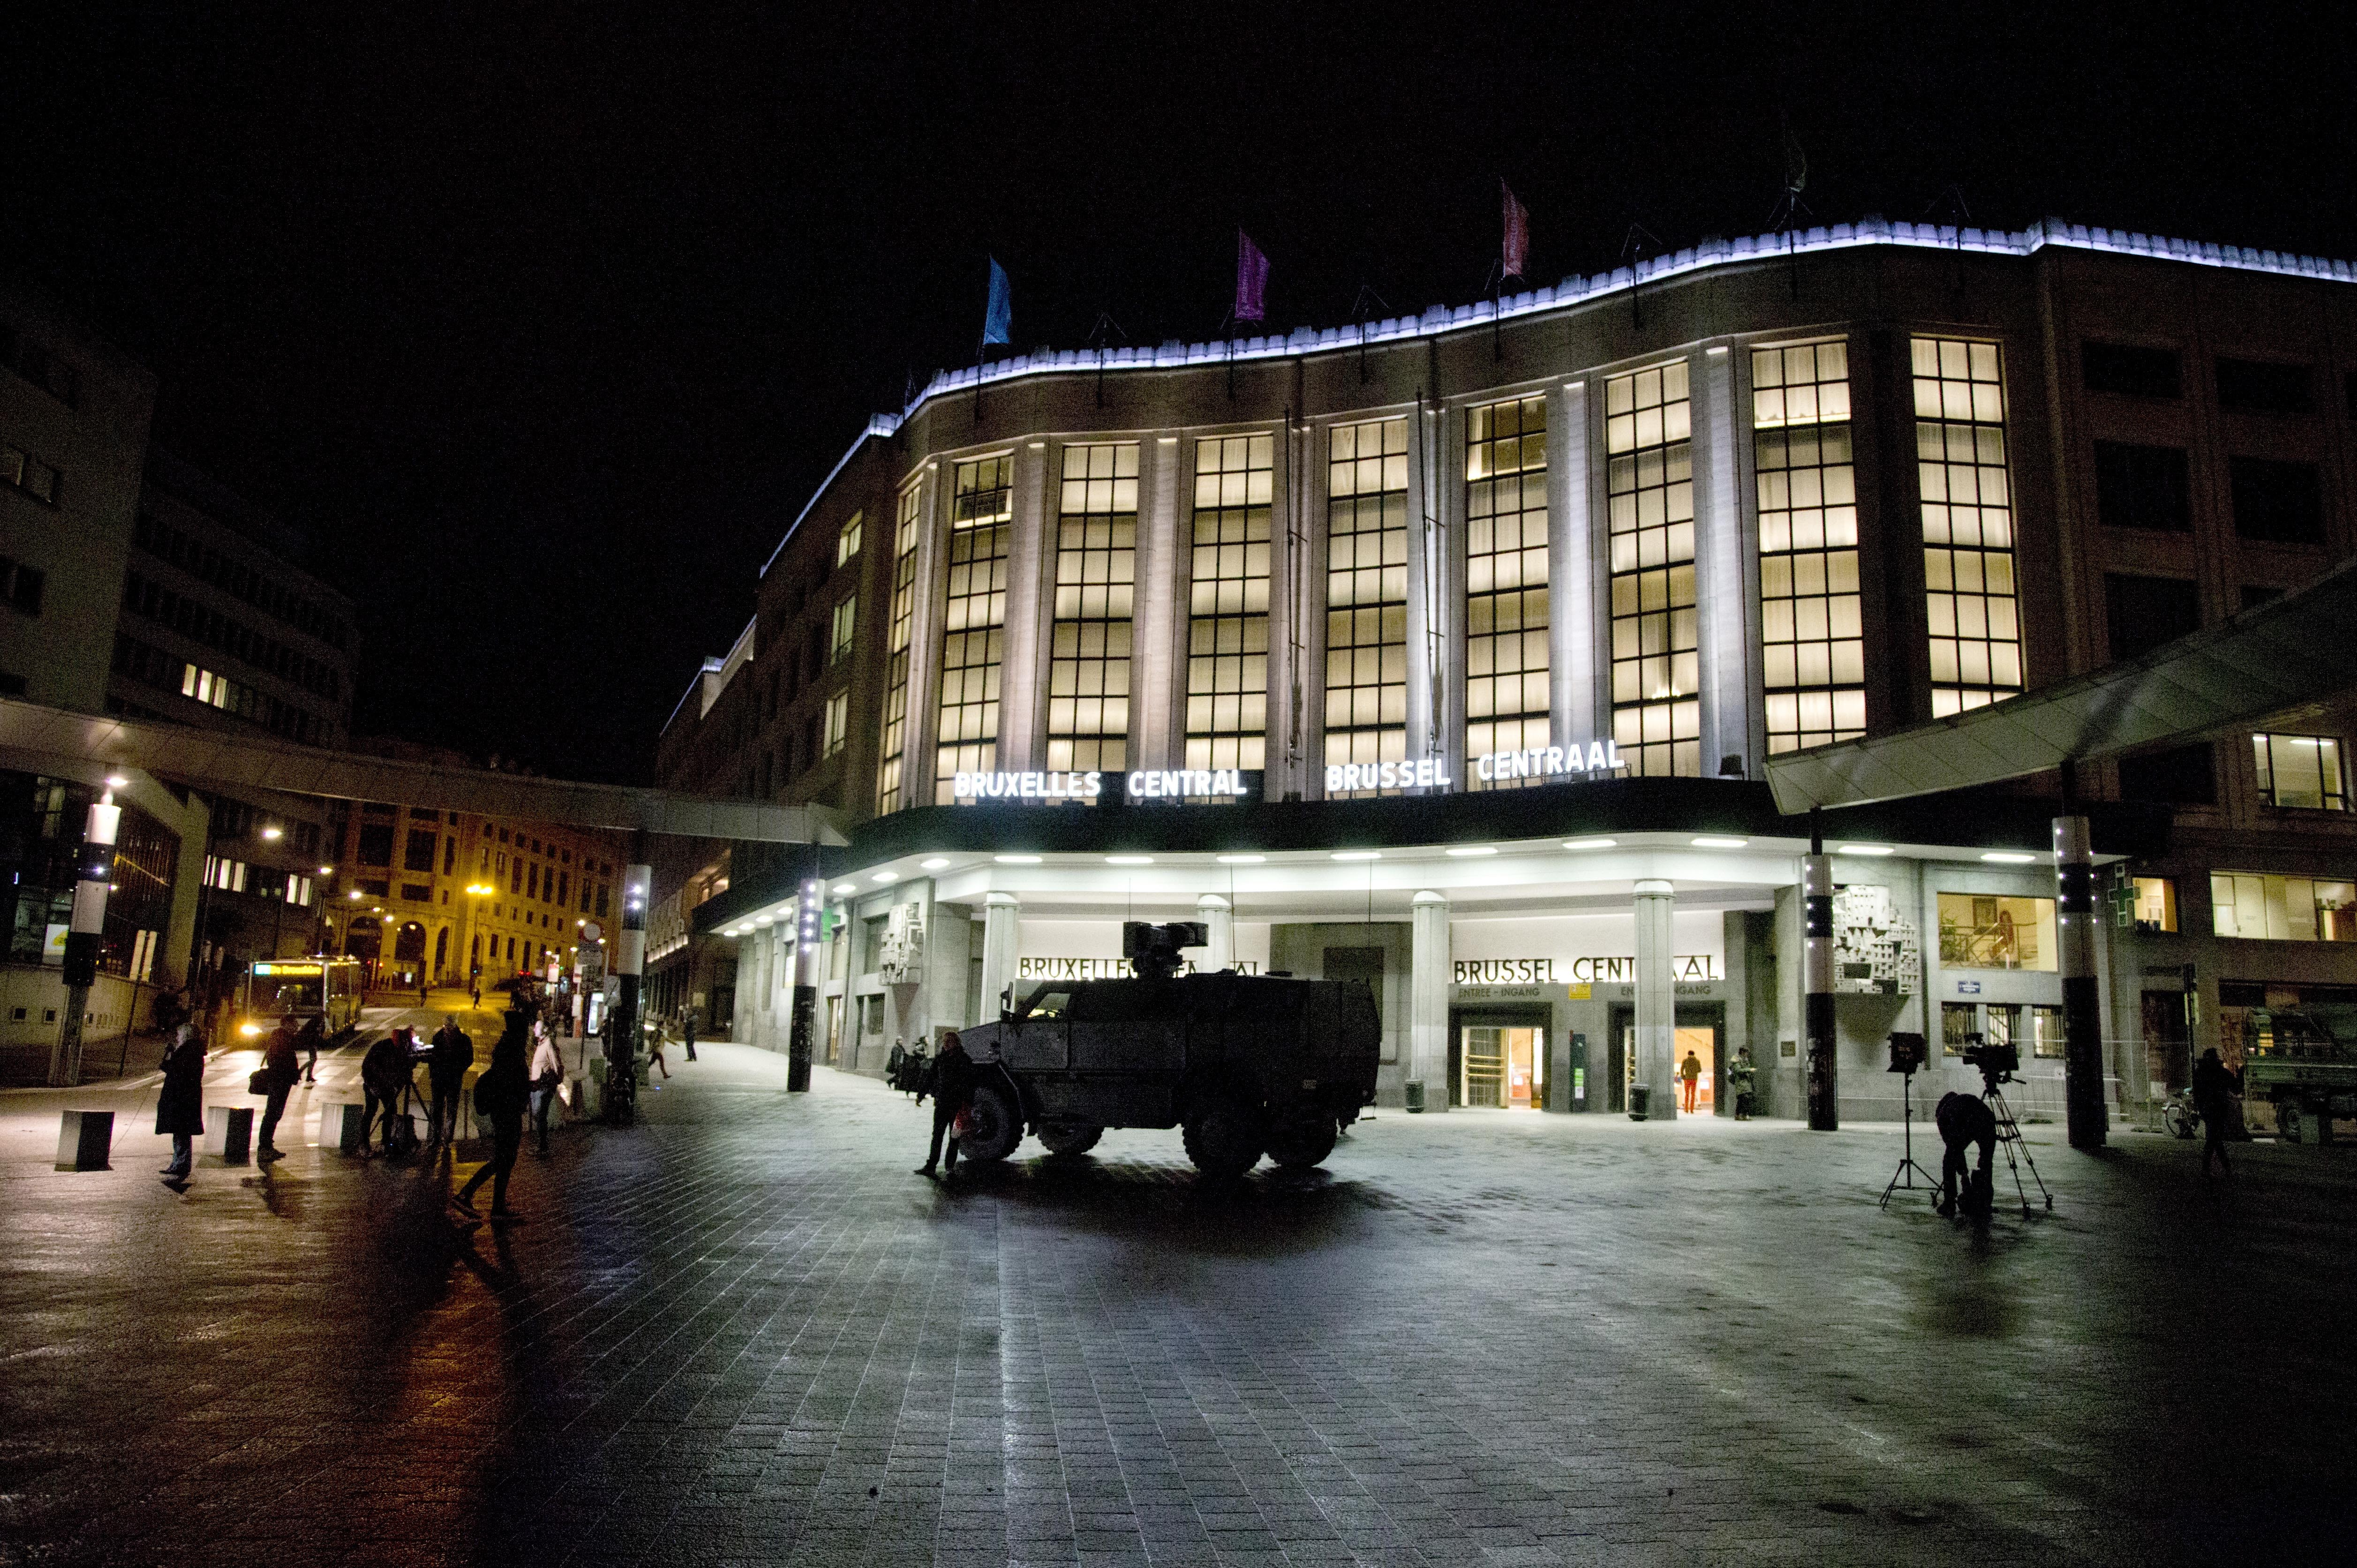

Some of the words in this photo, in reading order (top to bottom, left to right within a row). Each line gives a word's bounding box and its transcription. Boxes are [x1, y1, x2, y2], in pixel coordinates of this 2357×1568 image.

[1327, 758, 1450, 790] BRUSSEL
[1478, 739, 1625, 780] CENTRAAL
[954, 771, 1101, 797] BRUXELLES
[1129, 769, 1247, 796] CENTRAL
[1454, 959, 1558, 983] BRUSSEL
[1573, 955, 1718, 983] CENTAL
[1501, 987, 1540, 996] INGANG
